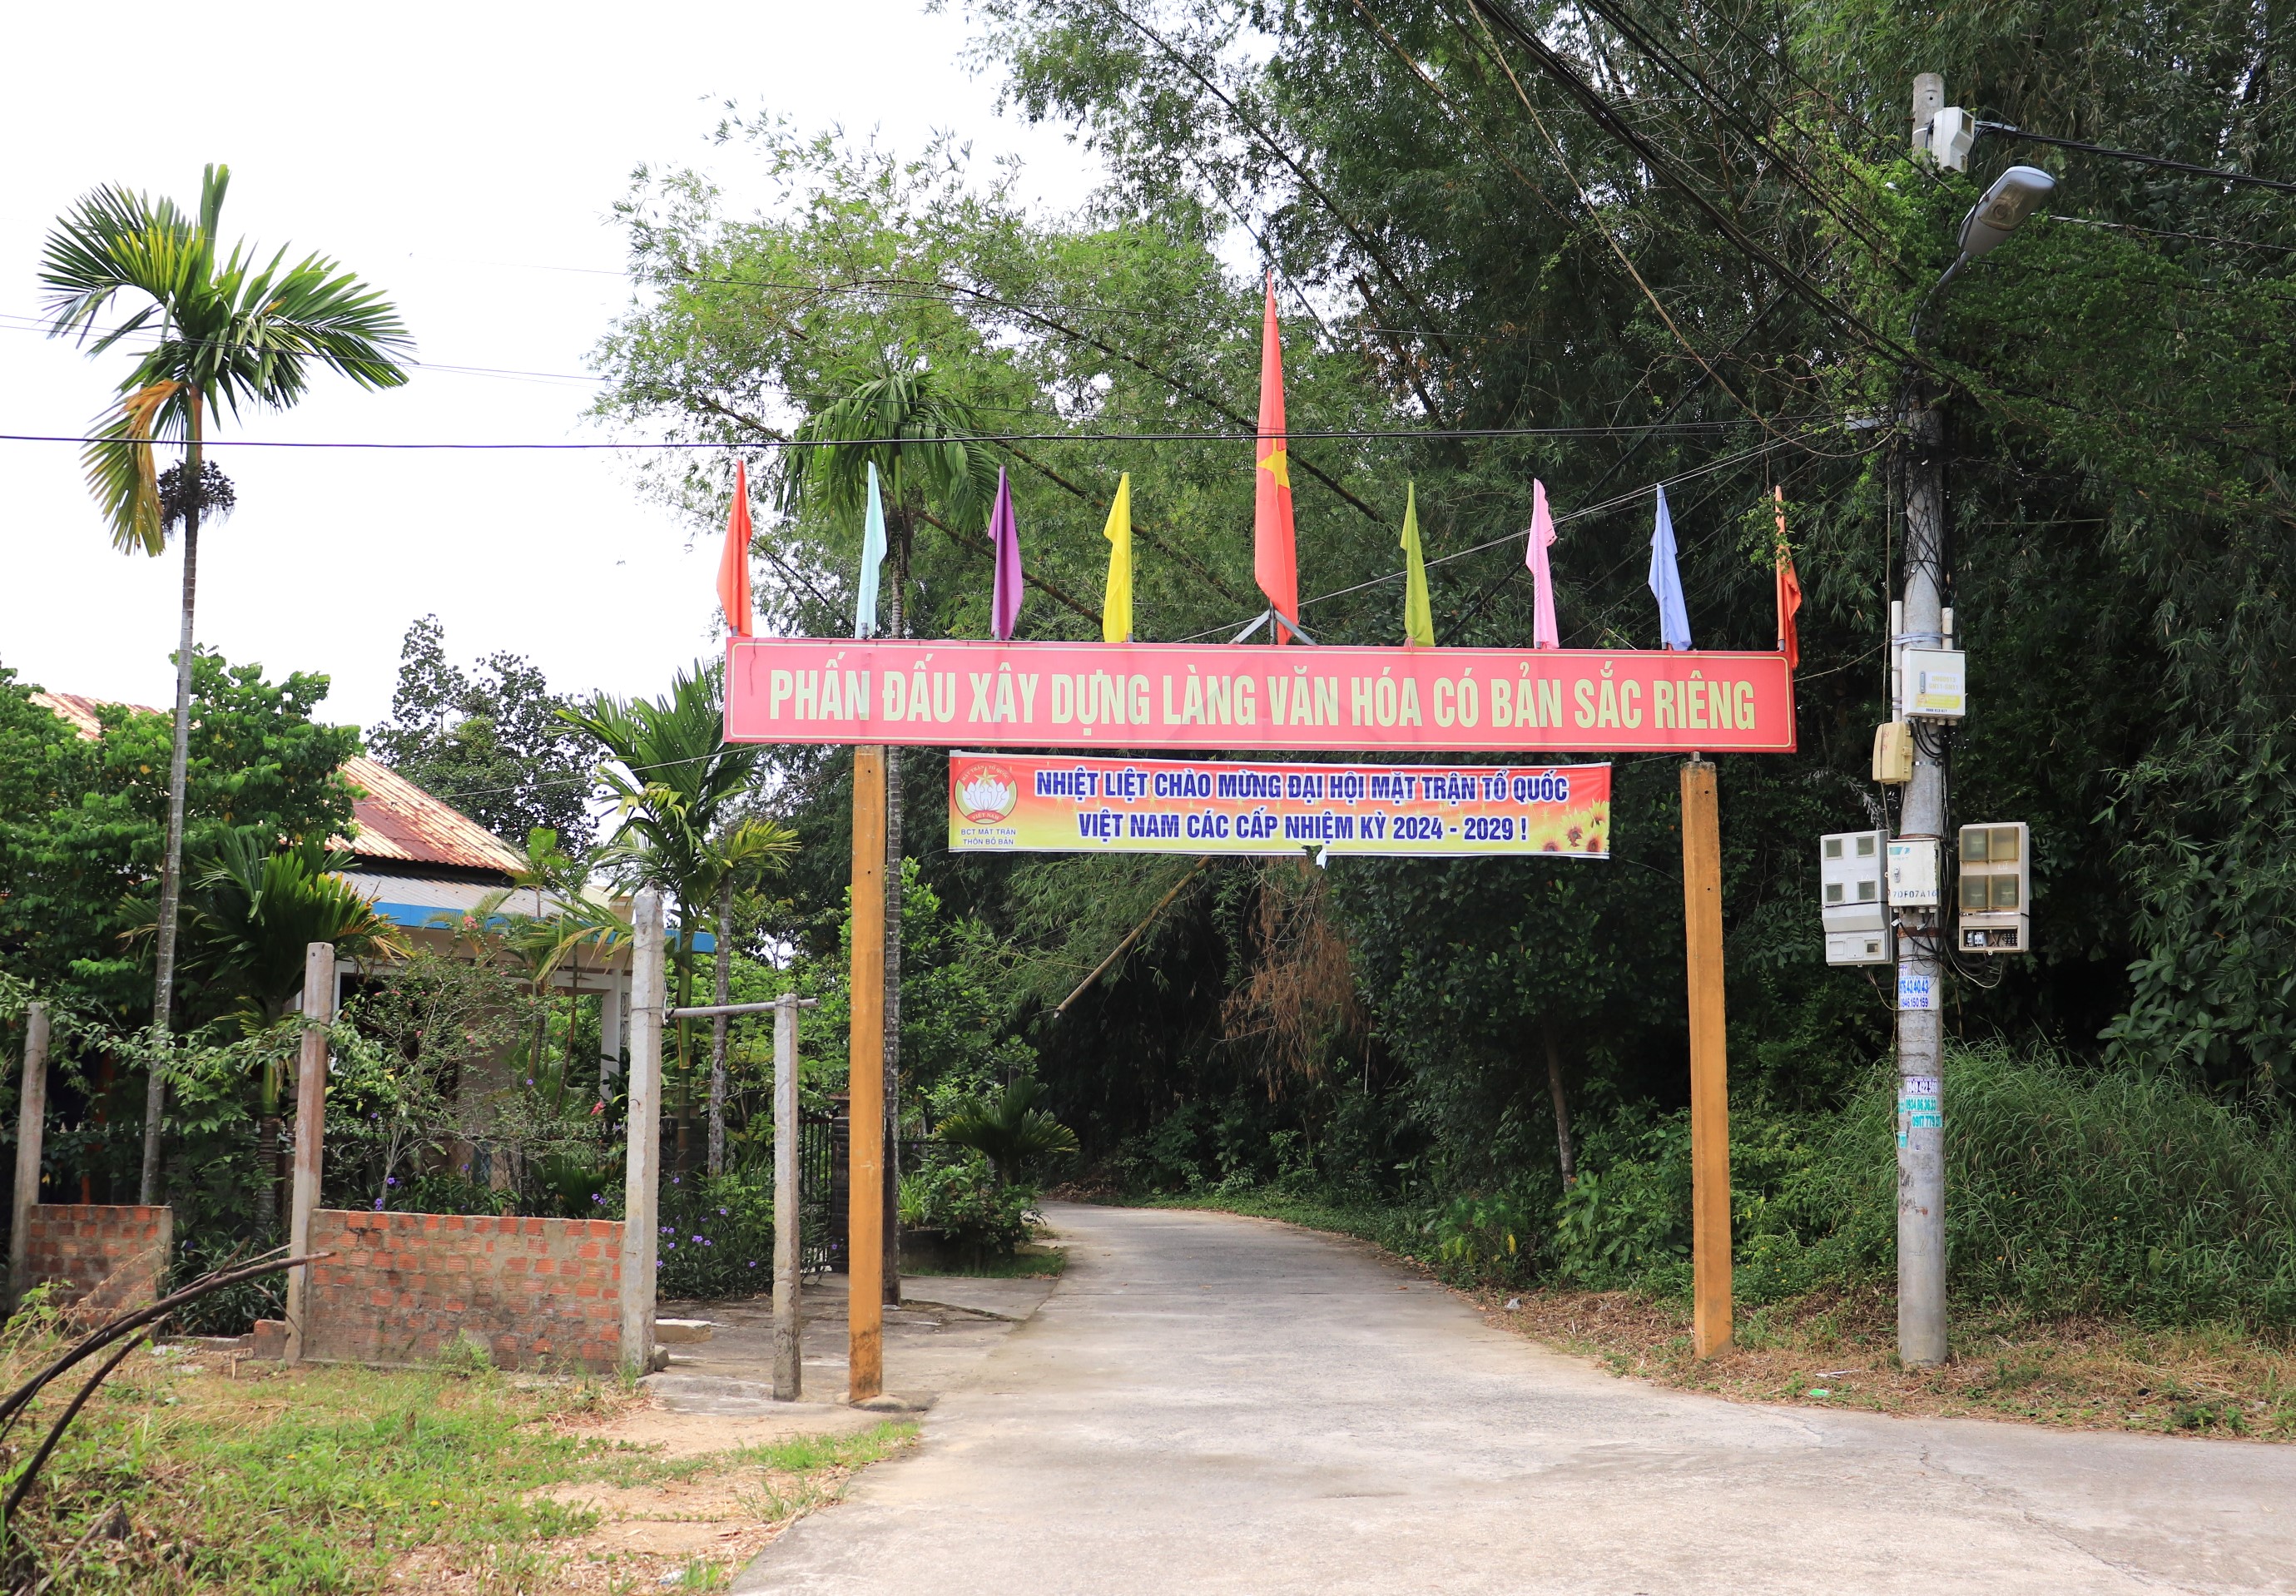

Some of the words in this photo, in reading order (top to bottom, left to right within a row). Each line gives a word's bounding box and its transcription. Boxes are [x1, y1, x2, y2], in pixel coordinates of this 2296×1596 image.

[769, 652, 869, 721] PHẤN
[882, 653, 956, 723] ĐẤU
[969, 662, 1040, 723] XÂY
[1052, 669, 1150, 736] DỰNG
[1164, 664, 1257, 725] LÀNG
[1267, 666, 1338, 726] VĂN
[1353, 667, 1422, 727] HÓA
[1433, 667, 1478, 728] CÓ
[1491, 661, 1563, 729] BẢN
[1574, 661, 1642, 730] SẮC
[1653, 670, 1755, 731] RIÊNG
[1037, 767, 1098, 800] NHIỆT
[1105, 770, 1148, 801] LIỆT
[1154, 768, 1211, 797] CHÀO
[1219, 771, 1281, 798] MỪNG
[1287, 775, 1323, 803] ĐẠI
[1331, 771, 1364, 804] HỘI
[1372, 772, 1416, 804] MẶT
[1421, 772, 1475, 805] TRẬN
[1482, 769, 1510, 800] TỔ
[1513, 770, 1568, 802] QUỐC
[1079, 810, 1123, 842] VIỆT
[1130, 815, 1179, 838] NAM
[1187, 810, 1228, 839] CÁC
[1237, 807, 1277, 839] CẤP
[1285, 811, 1353, 845] NHIỆM
[1361, 812, 1386, 840] KỲ
[1393, 816, 1443, 840] 2024
[1464, 817, 1513, 840] 2029
